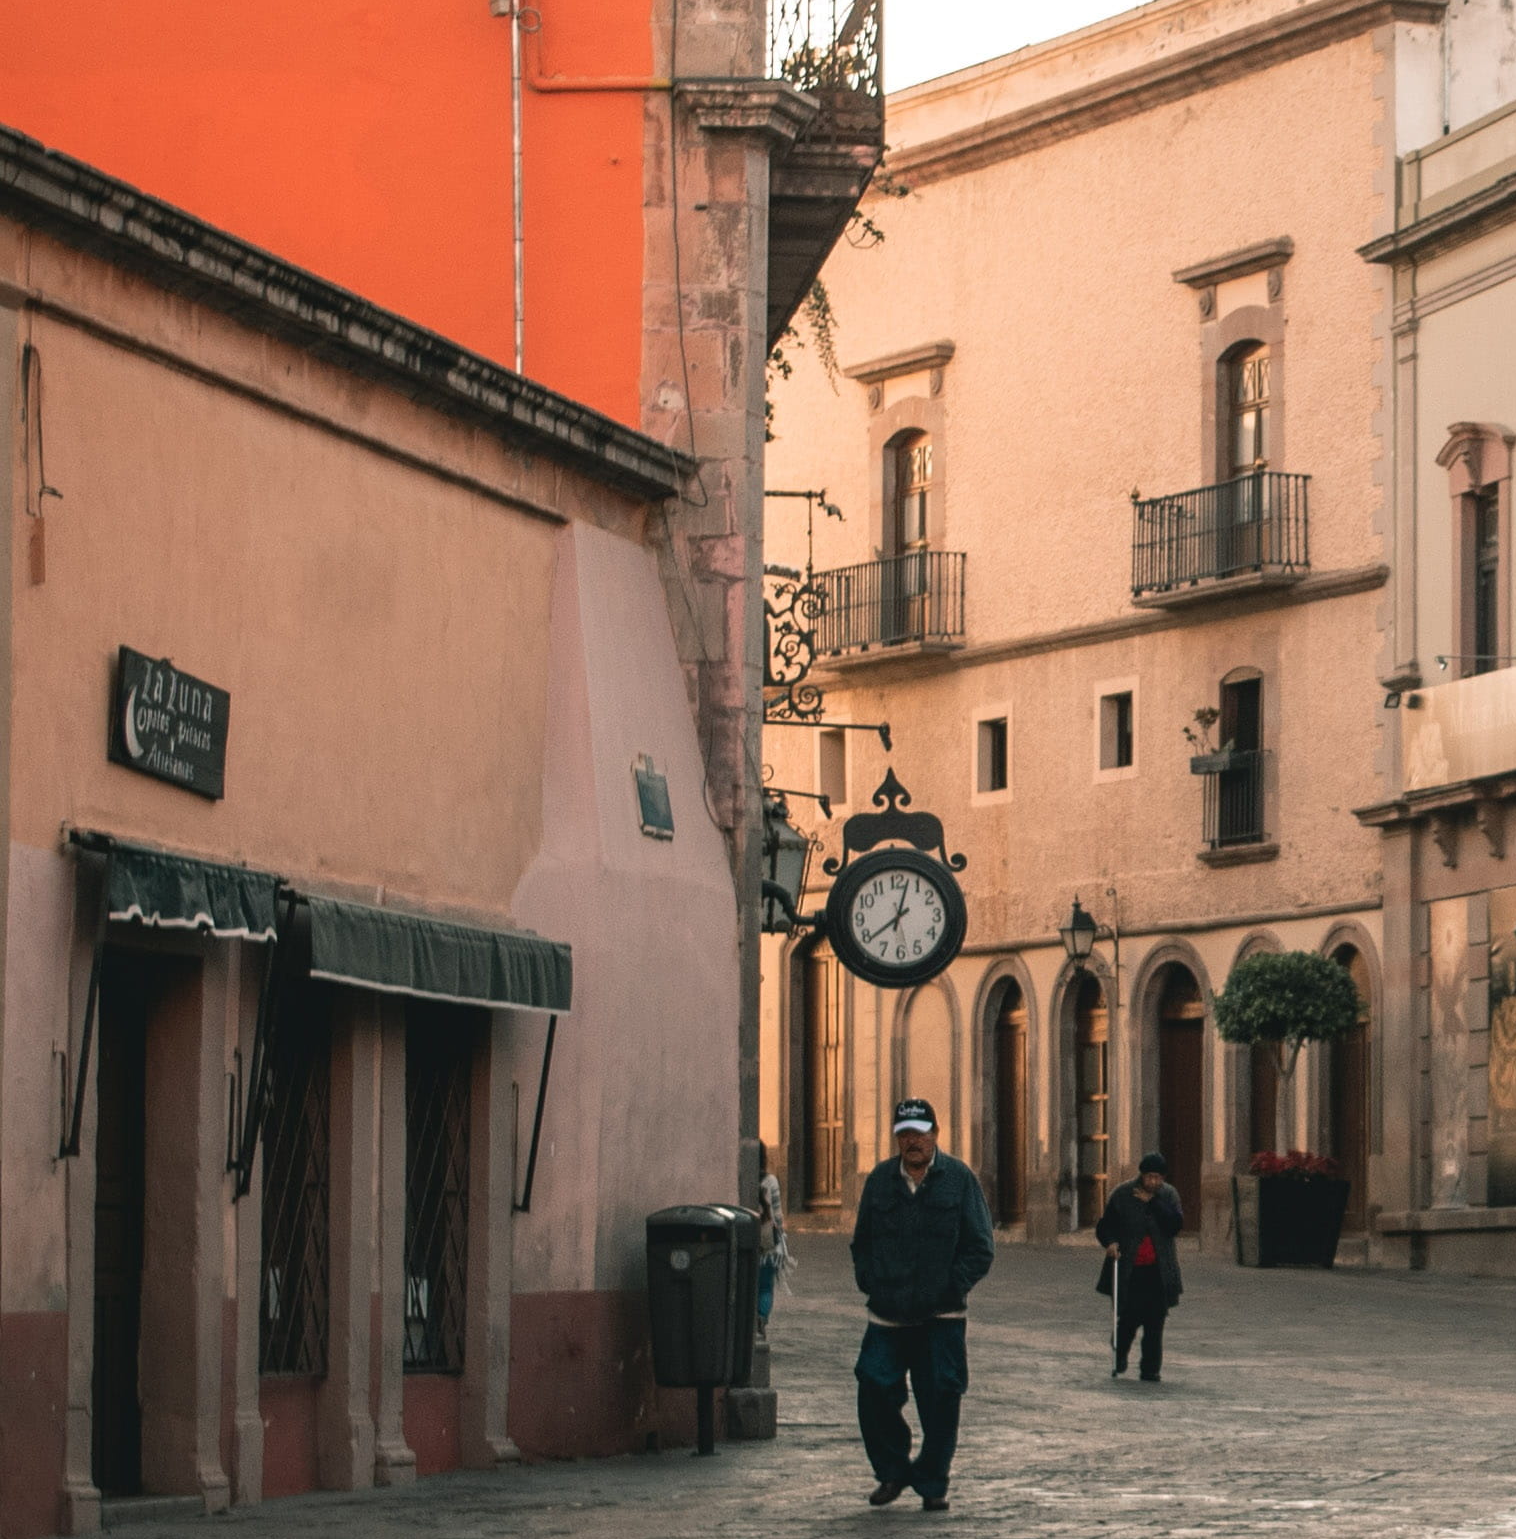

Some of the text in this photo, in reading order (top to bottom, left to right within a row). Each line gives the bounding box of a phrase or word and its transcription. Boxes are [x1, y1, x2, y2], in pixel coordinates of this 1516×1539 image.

[141, 660, 213, 724] La Luna
[873, 881, 884, 896] 11
[890, 874, 904, 888] 12
[914, 878, 921, 893] 1
[860, 893, 875, 909] 10
[925, 891, 935, 905] 2
[855, 911, 865, 927] 9
[932, 908, 942, 923] 3
[862, 927, 872, 943] 8
[926, 925, 937, 940] 4
[879, 941, 889, 956] 7
[896, 944, 906, 960] 6
[912, 940, 922, 955] 5
